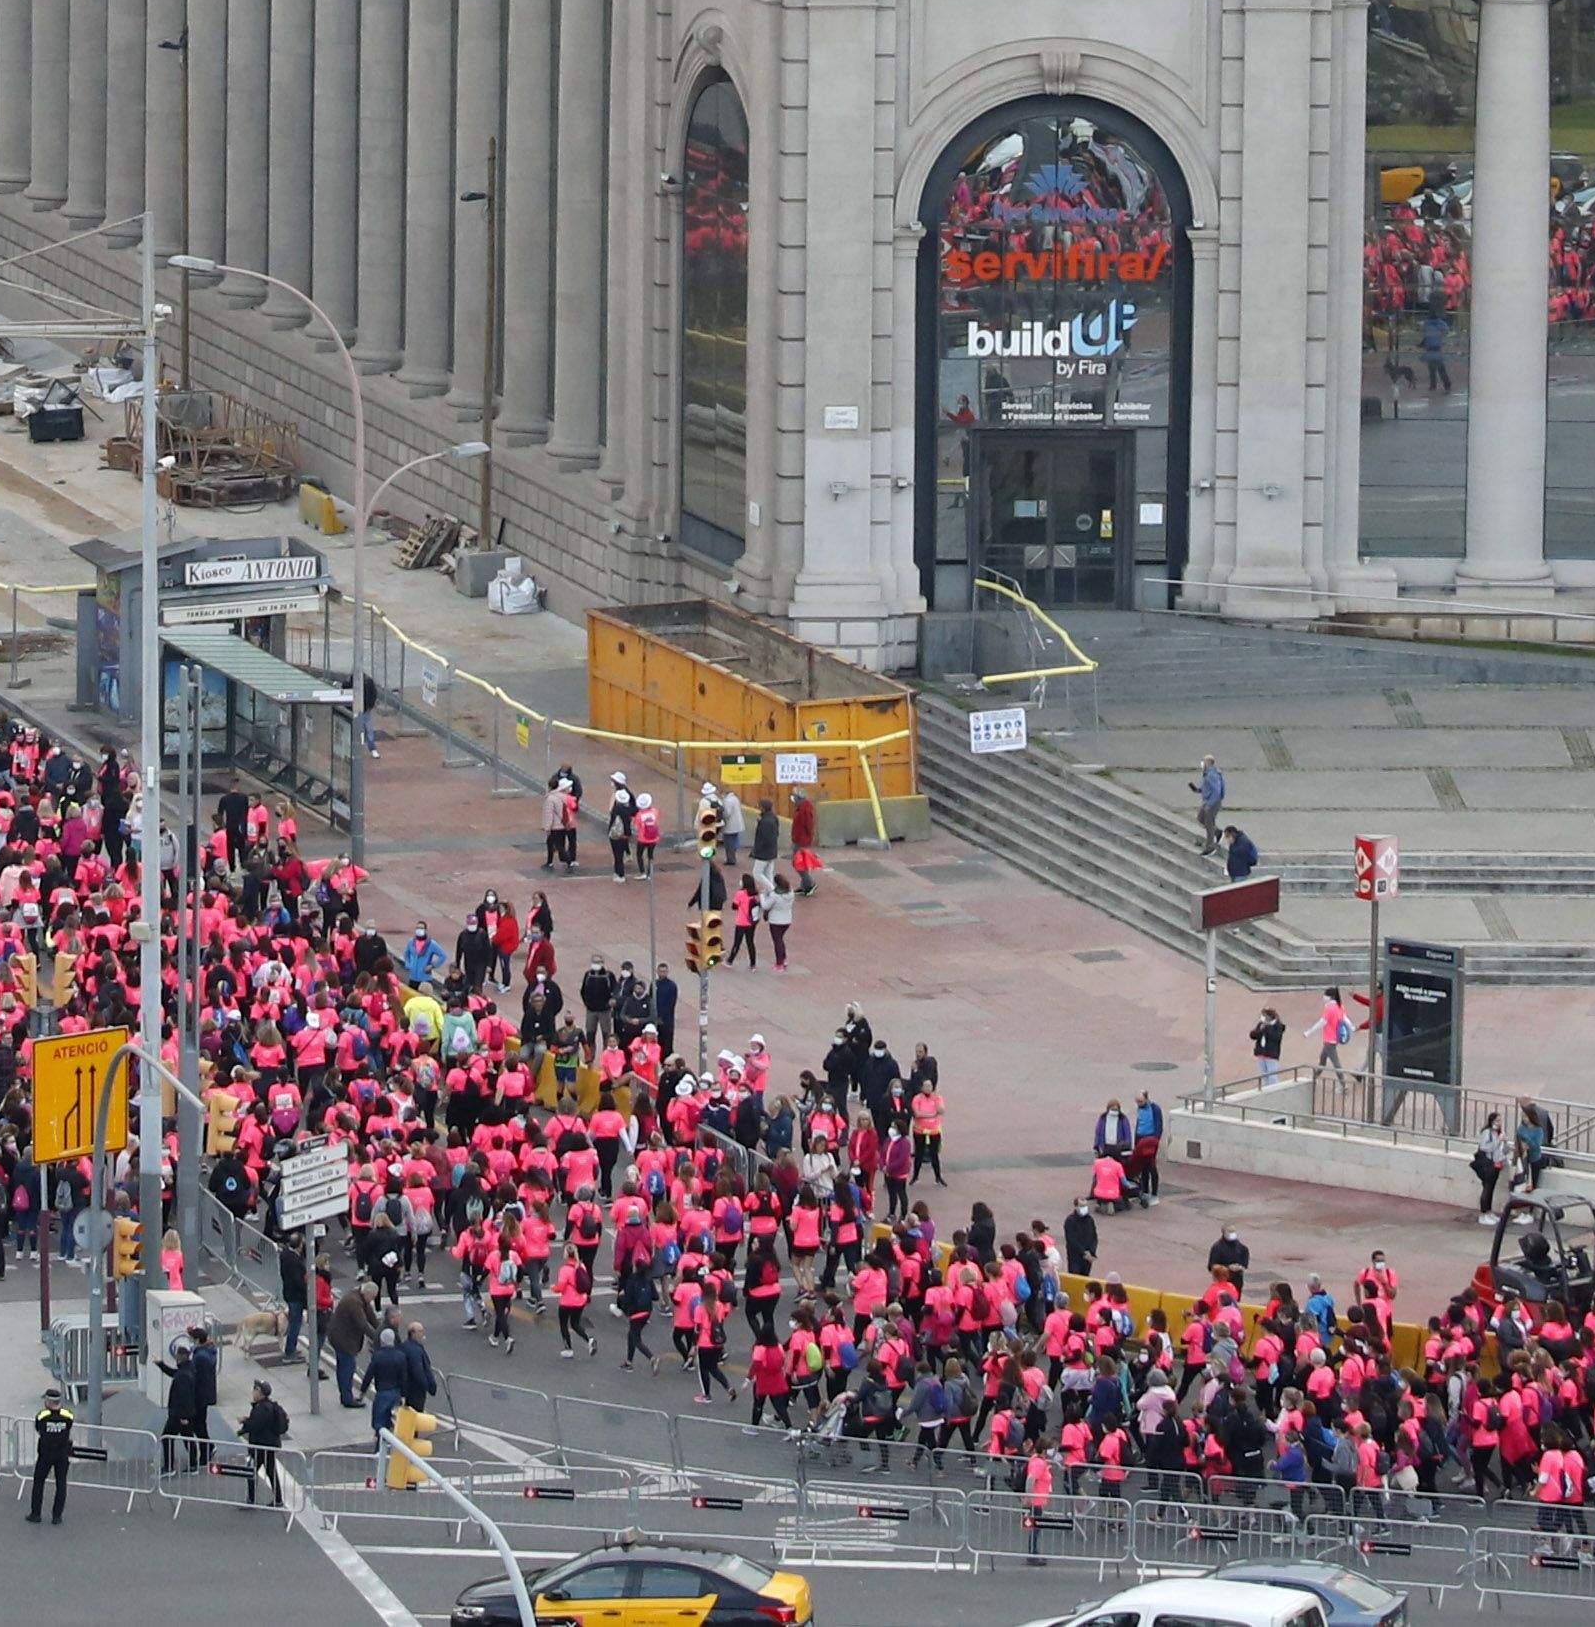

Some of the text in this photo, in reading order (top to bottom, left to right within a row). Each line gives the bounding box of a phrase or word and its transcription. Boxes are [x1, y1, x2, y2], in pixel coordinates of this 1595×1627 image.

[1056, 360, 1107, 378] by Fira
[1054, 401, 1093, 411] Servicios
[1113, 401, 1153, 411] Exhibitor
[1113, 412, 1151, 421] Services
[241, 559, 314, 582] ANTONIO
